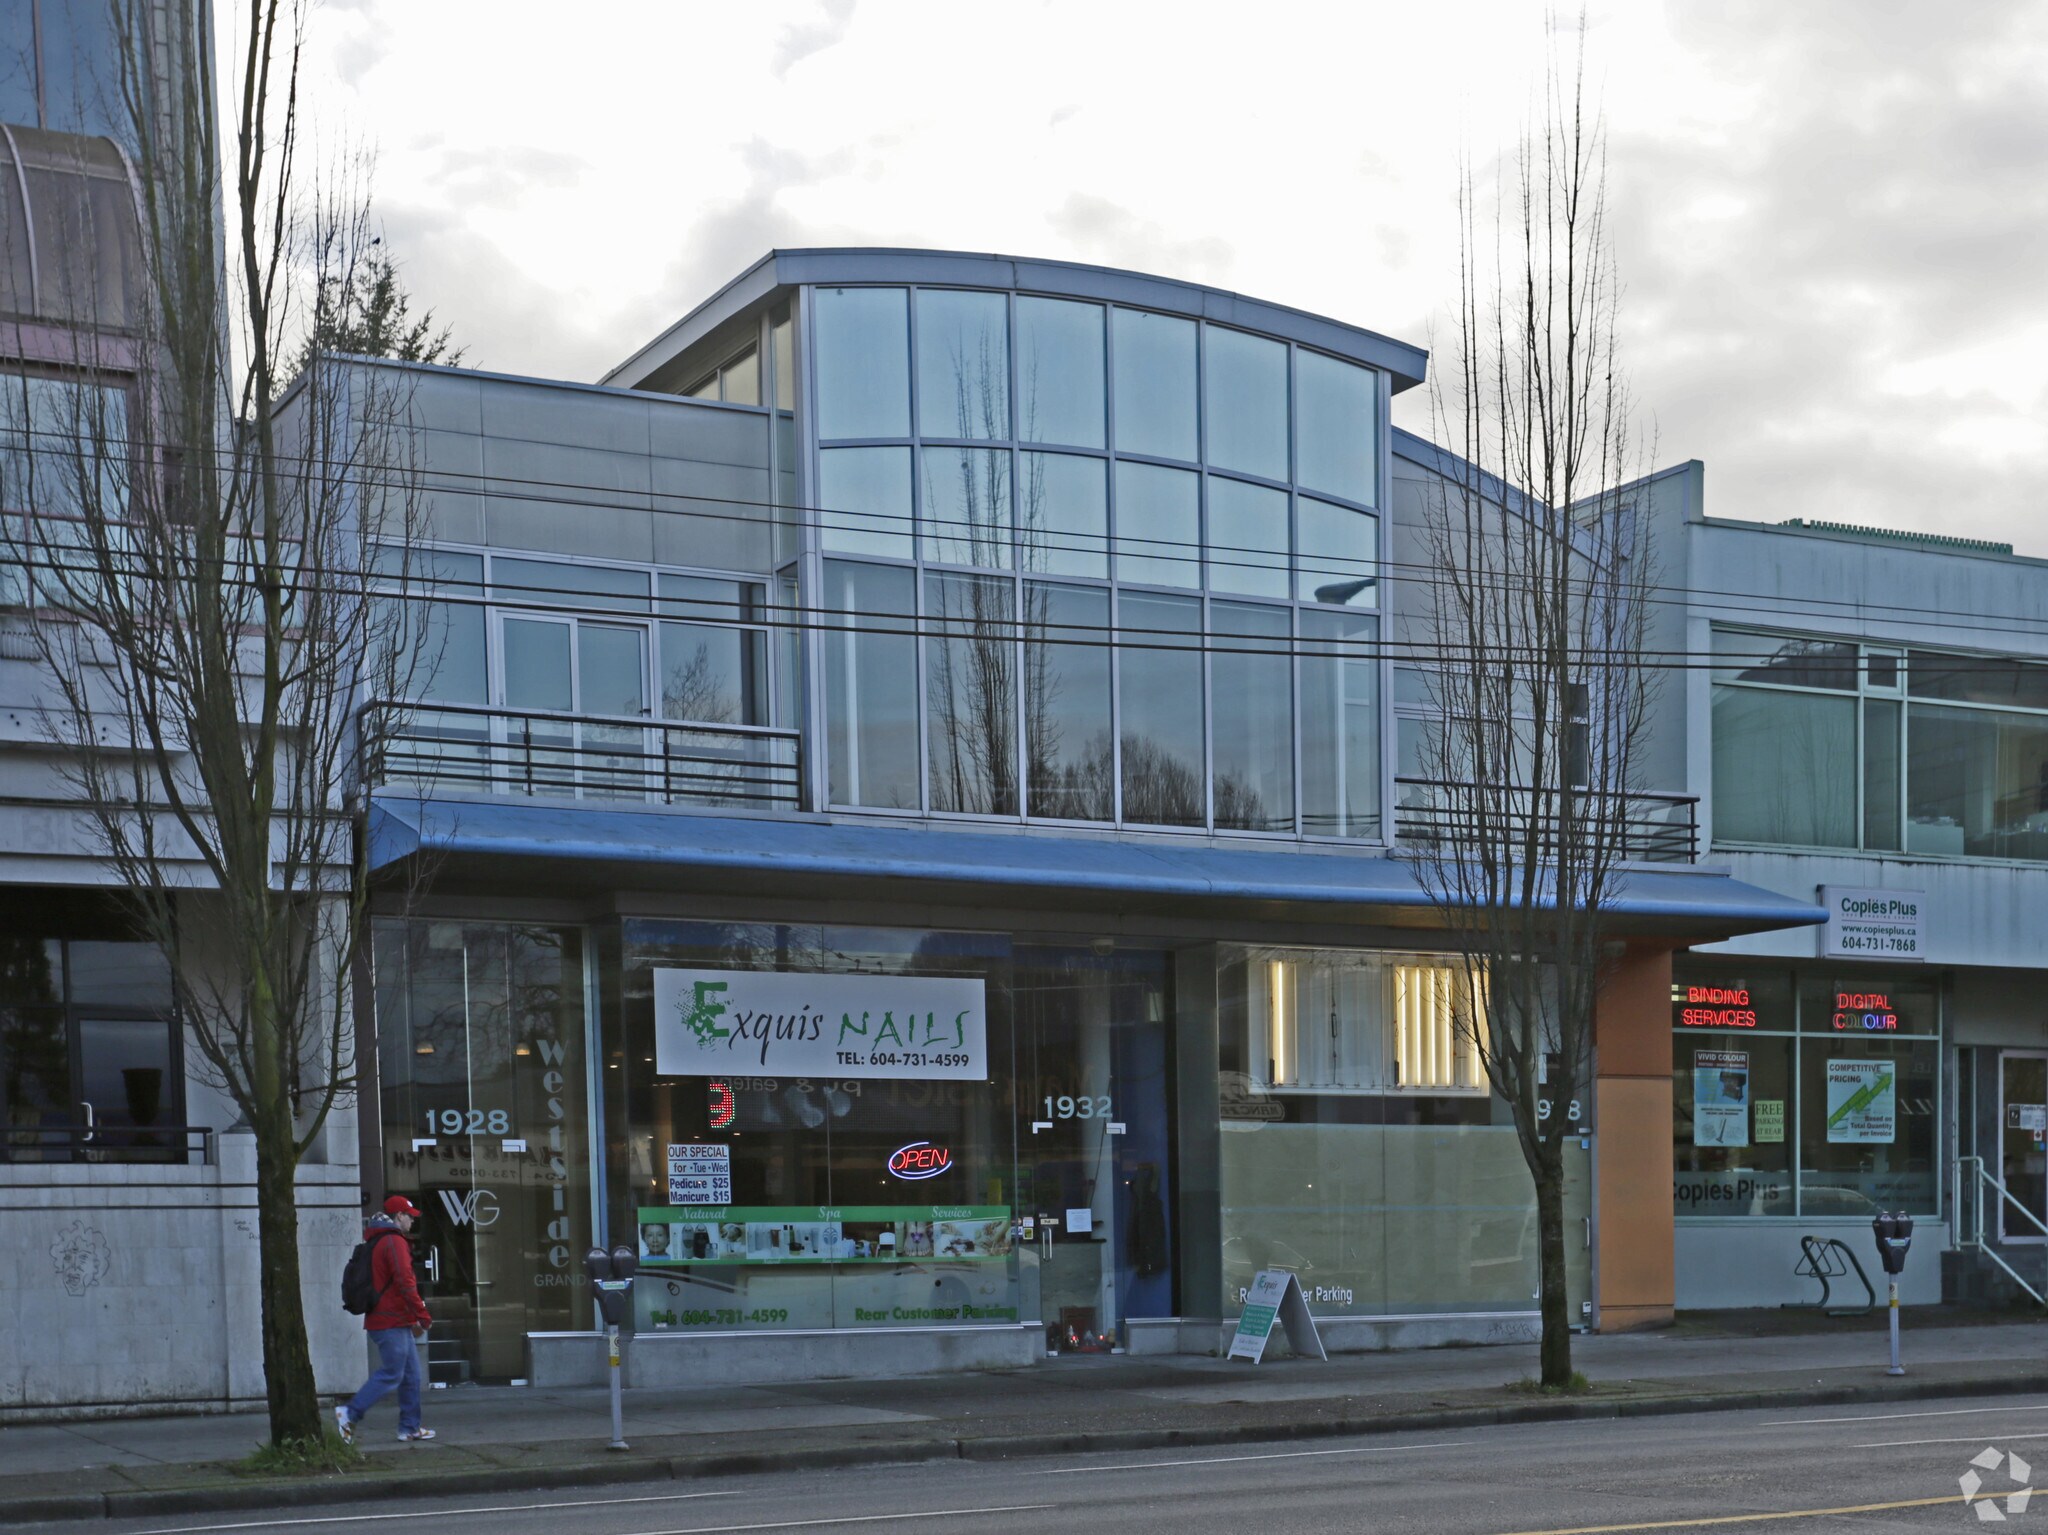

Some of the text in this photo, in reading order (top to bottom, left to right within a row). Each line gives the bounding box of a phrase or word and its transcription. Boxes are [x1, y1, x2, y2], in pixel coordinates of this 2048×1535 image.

[1841, 897, 1917, 918] Copies Plus
[1841, 925, 1916, 937] www.copiesplus.ca
[1841, 936, 1916, 952] 604-731-7868
[1688, 987, 1749, 1006] BINDING
[1837, 993, 1892, 1010] DIGITAL
[679, 980, 970, 1066] Exquis NAILS
[1682, 1008, 1756, 1027] SERVICES
[1833, 1013, 1897, 1030] COLOUR
[836, 1051, 970, 1067] TEL: 604-731-4599
[1697, 1053, 1746, 1062] VIVID COLOUR
[1829, 1063, 1881, 1073] COMPETITIVE
[1829, 1075, 1862, 1083] PRICING
[1044, 1096, 1113, 1119] 1932
[1755, 1103, 1783, 1115] FREE
[426, 1108, 509, 1135] 1928
[1755, 1117, 1783, 1125] PARKING
[1866, 1123, 1893, 1131] Quantity
[668, 1146, 728, 1158] OUR SPECIAL
[890, 1148, 949, 1170] OPEN
[673, 1162, 687, 1173] for
[669, 1177, 729, 1189] Pedicure $25
[1737, 1179, 1780, 1201] Plus
[670, 1190, 730, 1202] Manicure $15
[680, 1205, 972, 1221] Natural Spa Services
[534, 1273, 587, 1288] GRAND
[1315, 1286, 1353, 1305] Parking
[855, 1303, 1018, 1321] Rear Customer Parking
